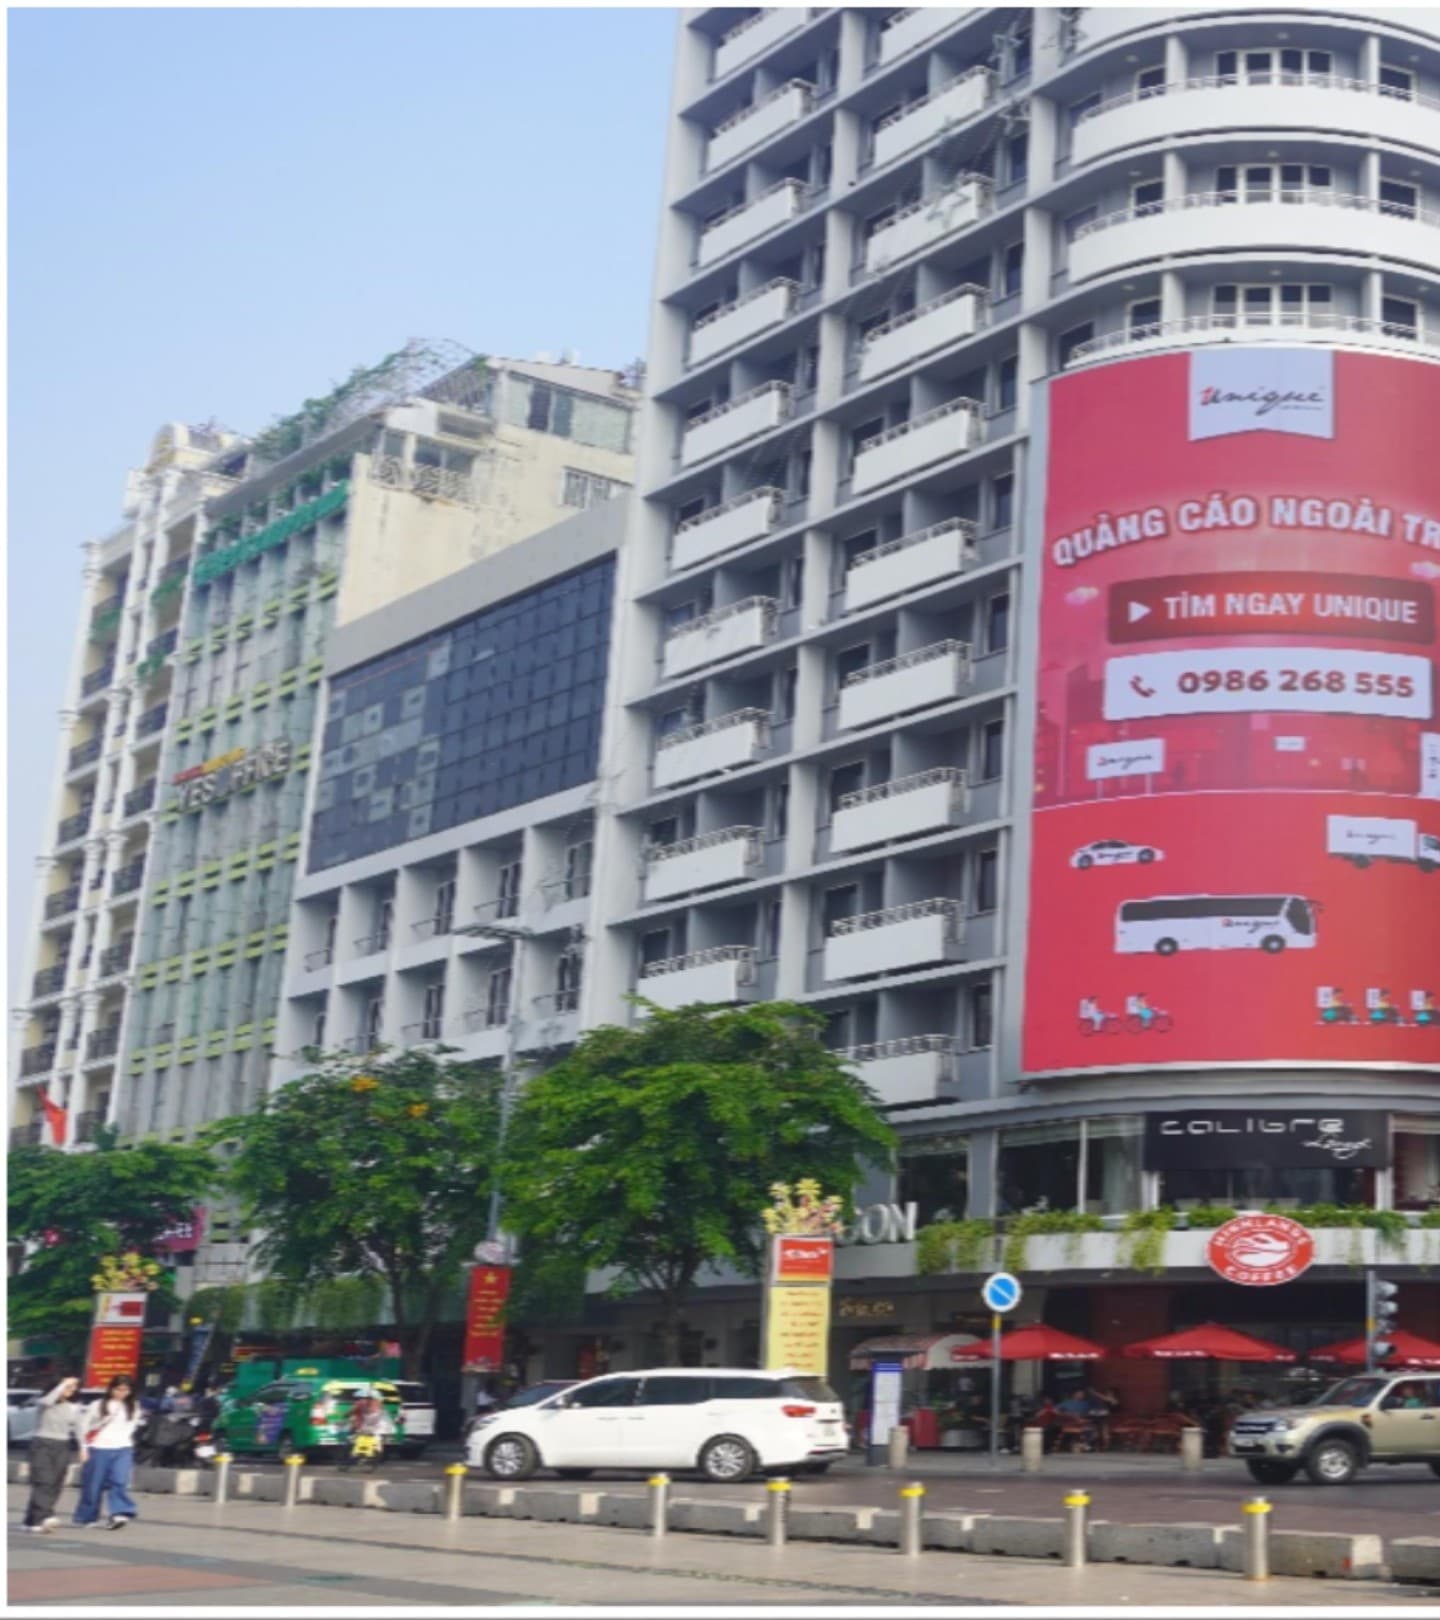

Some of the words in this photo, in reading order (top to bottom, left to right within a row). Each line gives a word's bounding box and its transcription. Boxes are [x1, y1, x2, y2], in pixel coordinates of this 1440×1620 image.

[1052, 507, 1166, 566] QUẢNG
[1177, 493, 1257, 532] CÁO
[1270, 497, 1390, 536] NGOÀI
[1164, 592, 1216, 620] TÌM
[1224, 592, 1303, 617] NGAY
[1313, 595, 1418, 624] UNIQUE
[1177, 670, 1268, 694] 0986
[1279, 669, 1345, 694] 268
[1355, 673, 1415, 698] 555
[850, 1201, 918, 1244] ON
